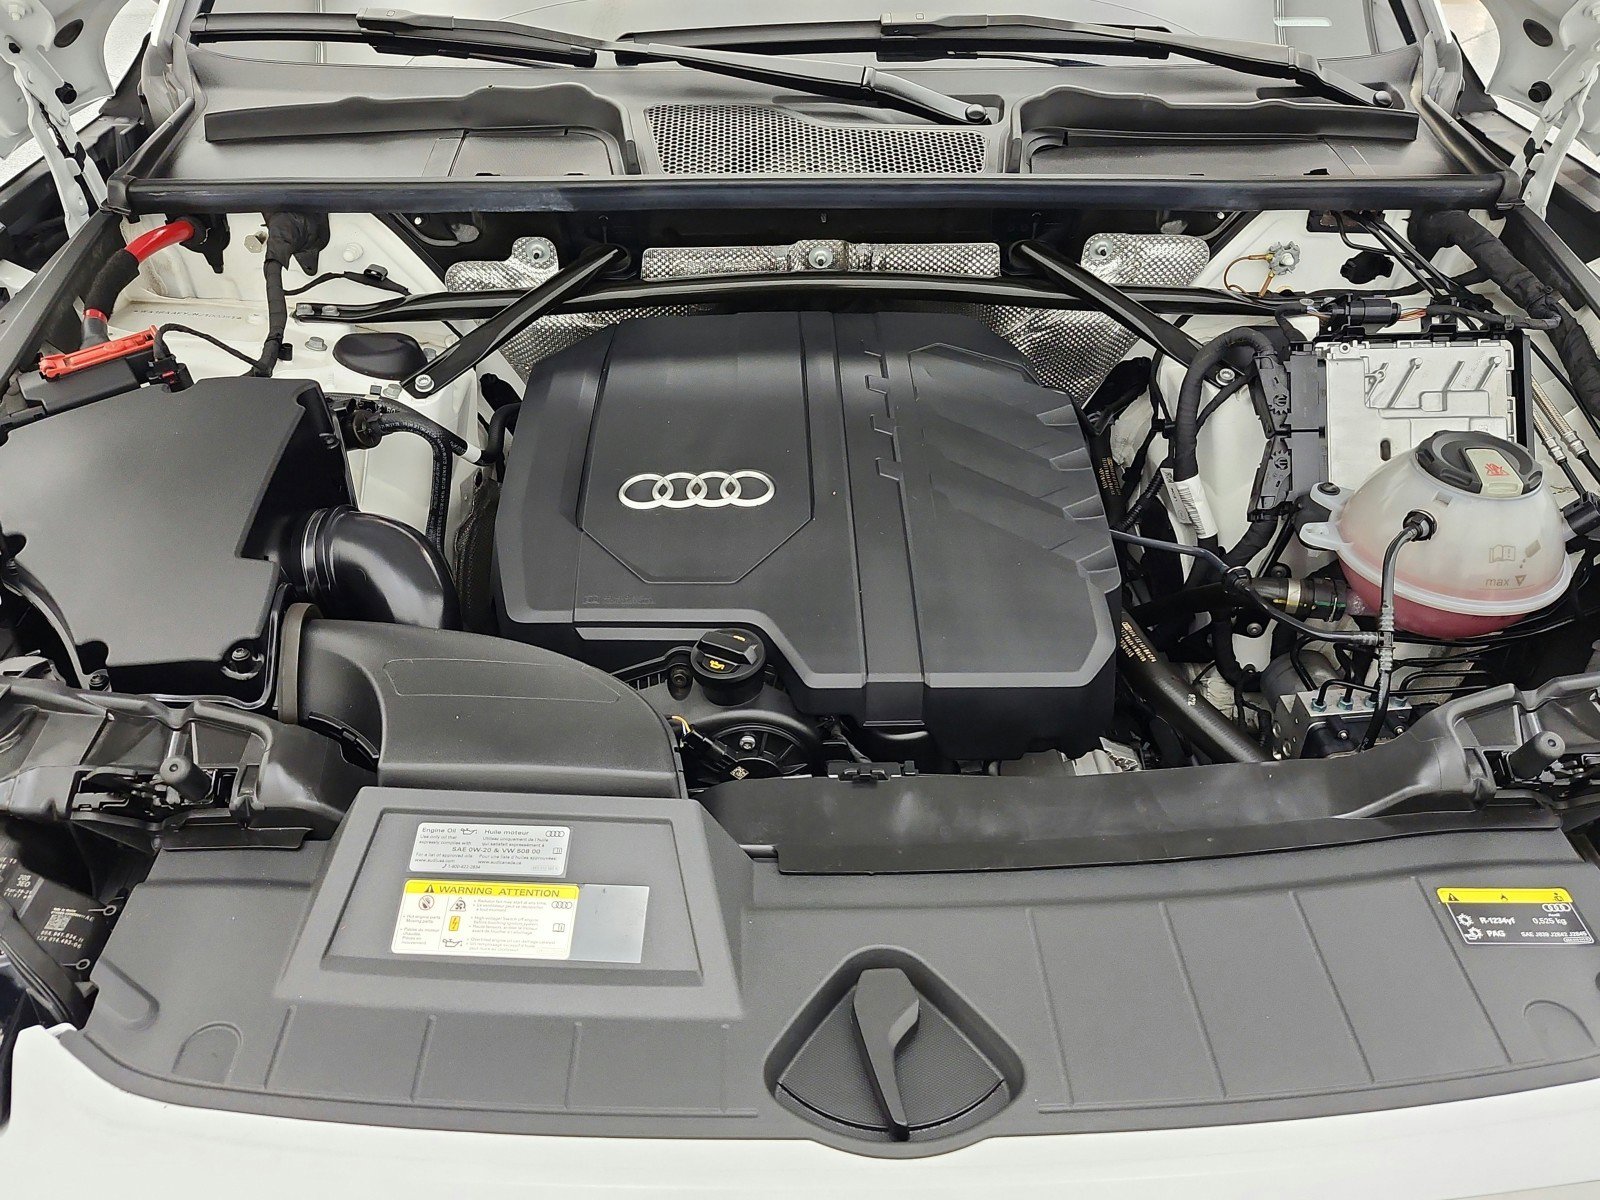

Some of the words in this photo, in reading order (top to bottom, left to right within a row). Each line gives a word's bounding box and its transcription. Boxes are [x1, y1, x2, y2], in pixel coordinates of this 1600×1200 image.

[1485, 578, 1509, 587] max
[439, 886, 493, 895] WARNING
[498, 888, 560, 898] ATTENTION
[1478, 916, 1516, 926] R-1234yf
[1532, 917, 1555, 926] 0,525
[1555, 917, 1568, 926] kg
[1485, 929, 1506, 938] PAG
